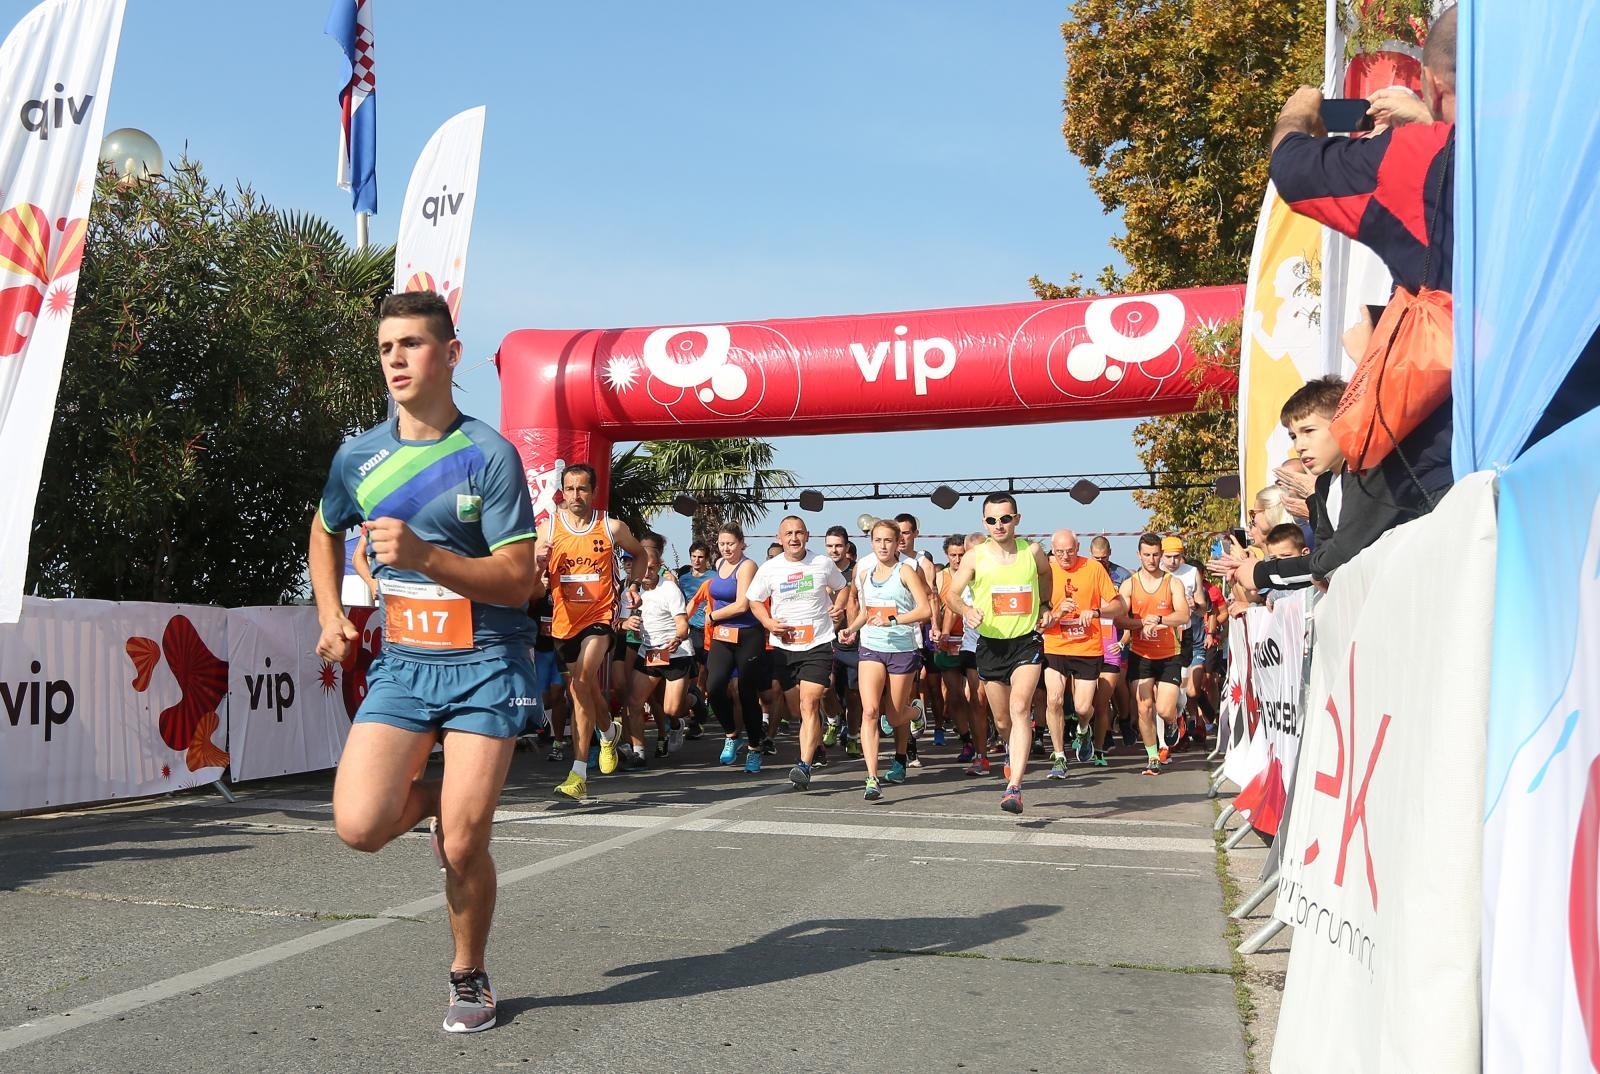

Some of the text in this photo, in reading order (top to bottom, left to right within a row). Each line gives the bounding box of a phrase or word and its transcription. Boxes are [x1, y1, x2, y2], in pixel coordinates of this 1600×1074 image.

[850, 325, 957, 396] vip
[576, 586, 585, 597] 4
[1009, 597, 1018, 609] 3
[402, 608, 449, 634] 117
[1067, 627, 1085, 636] 133
[0, 660, 75, 742] vip
[244, 656, 295, 723] vip
